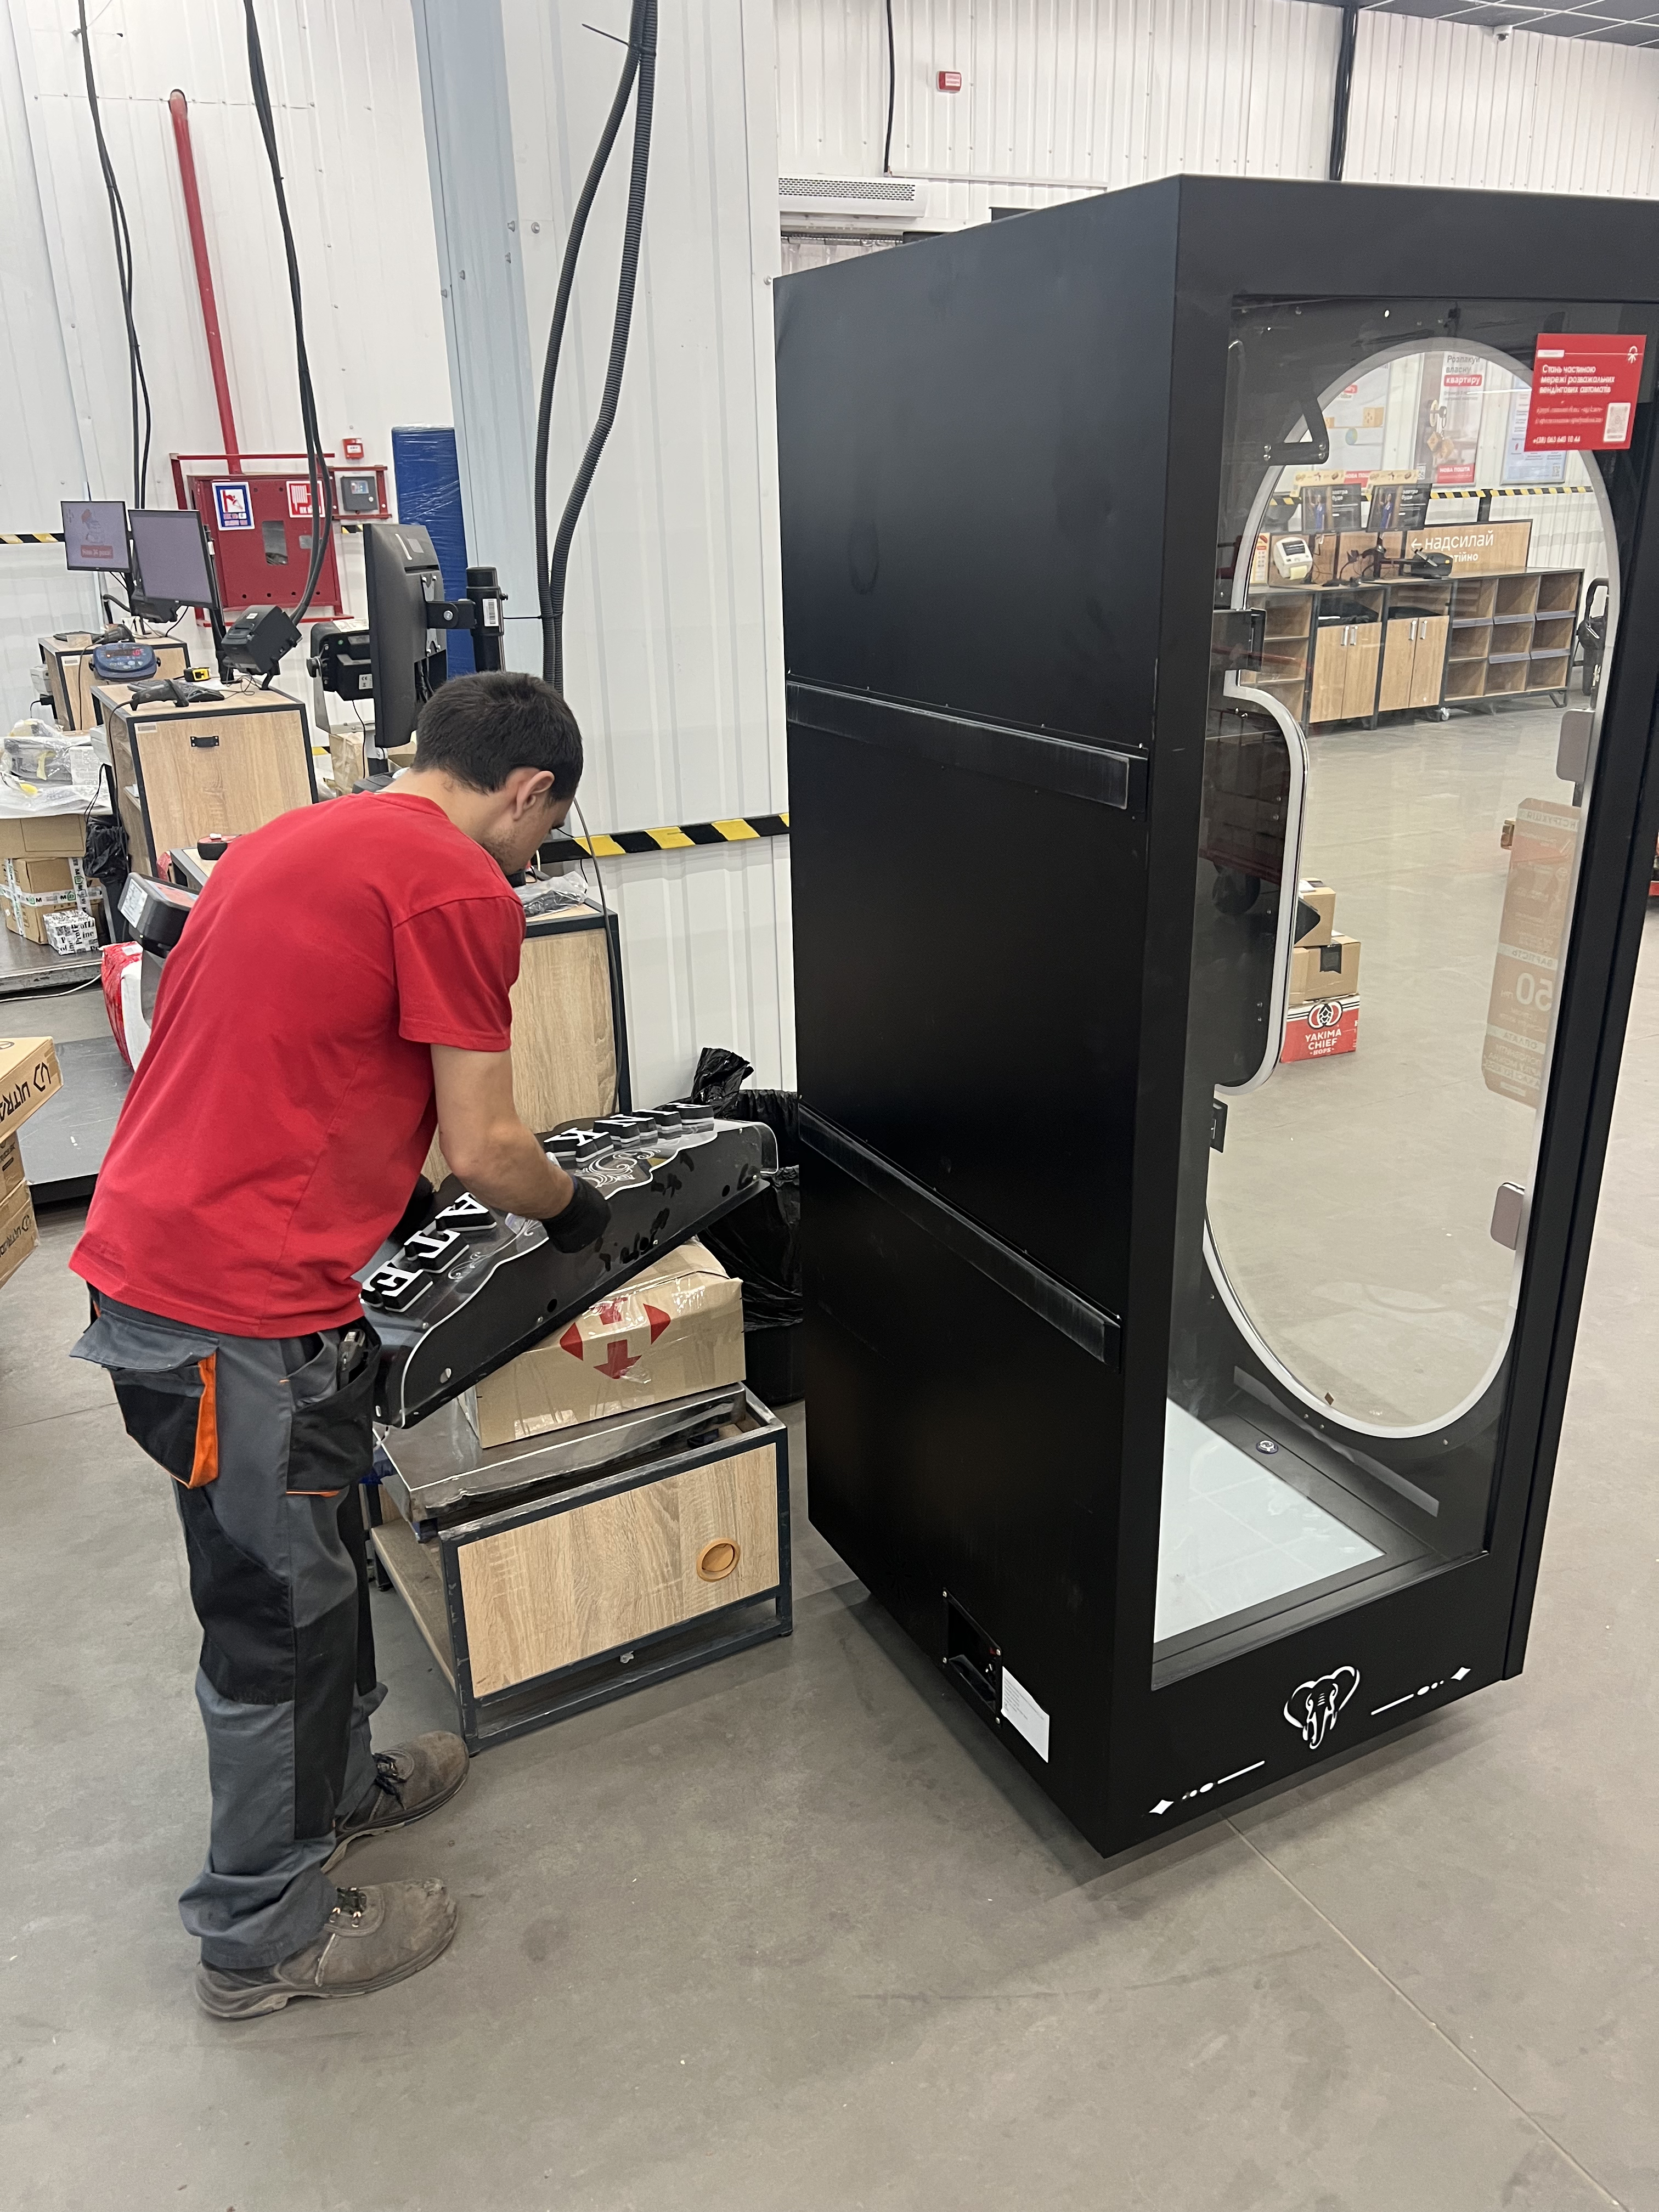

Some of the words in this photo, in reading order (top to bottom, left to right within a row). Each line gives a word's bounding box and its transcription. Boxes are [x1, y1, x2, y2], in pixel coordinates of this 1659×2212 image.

[1447, 355, 1480, 364] Розпакуй
[1542, 364, 1562, 373] Стань
[1446, 376, 1481, 386] квартиру
[1541, 375, 1567, 384] мережі
[1567, 375, 1615, 384] розважальних
[1539, 386, 1578, 394] вендінгових
[1579, 385, 1611, 394] автоматів
[1425, 529, 1494, 551] надсилай
[1305, 1028, 1342, 1043] YAKIMA
[1308, 1037, 1338, 1051] CHIEF
[362, 1192, 489, 1297] ATE
